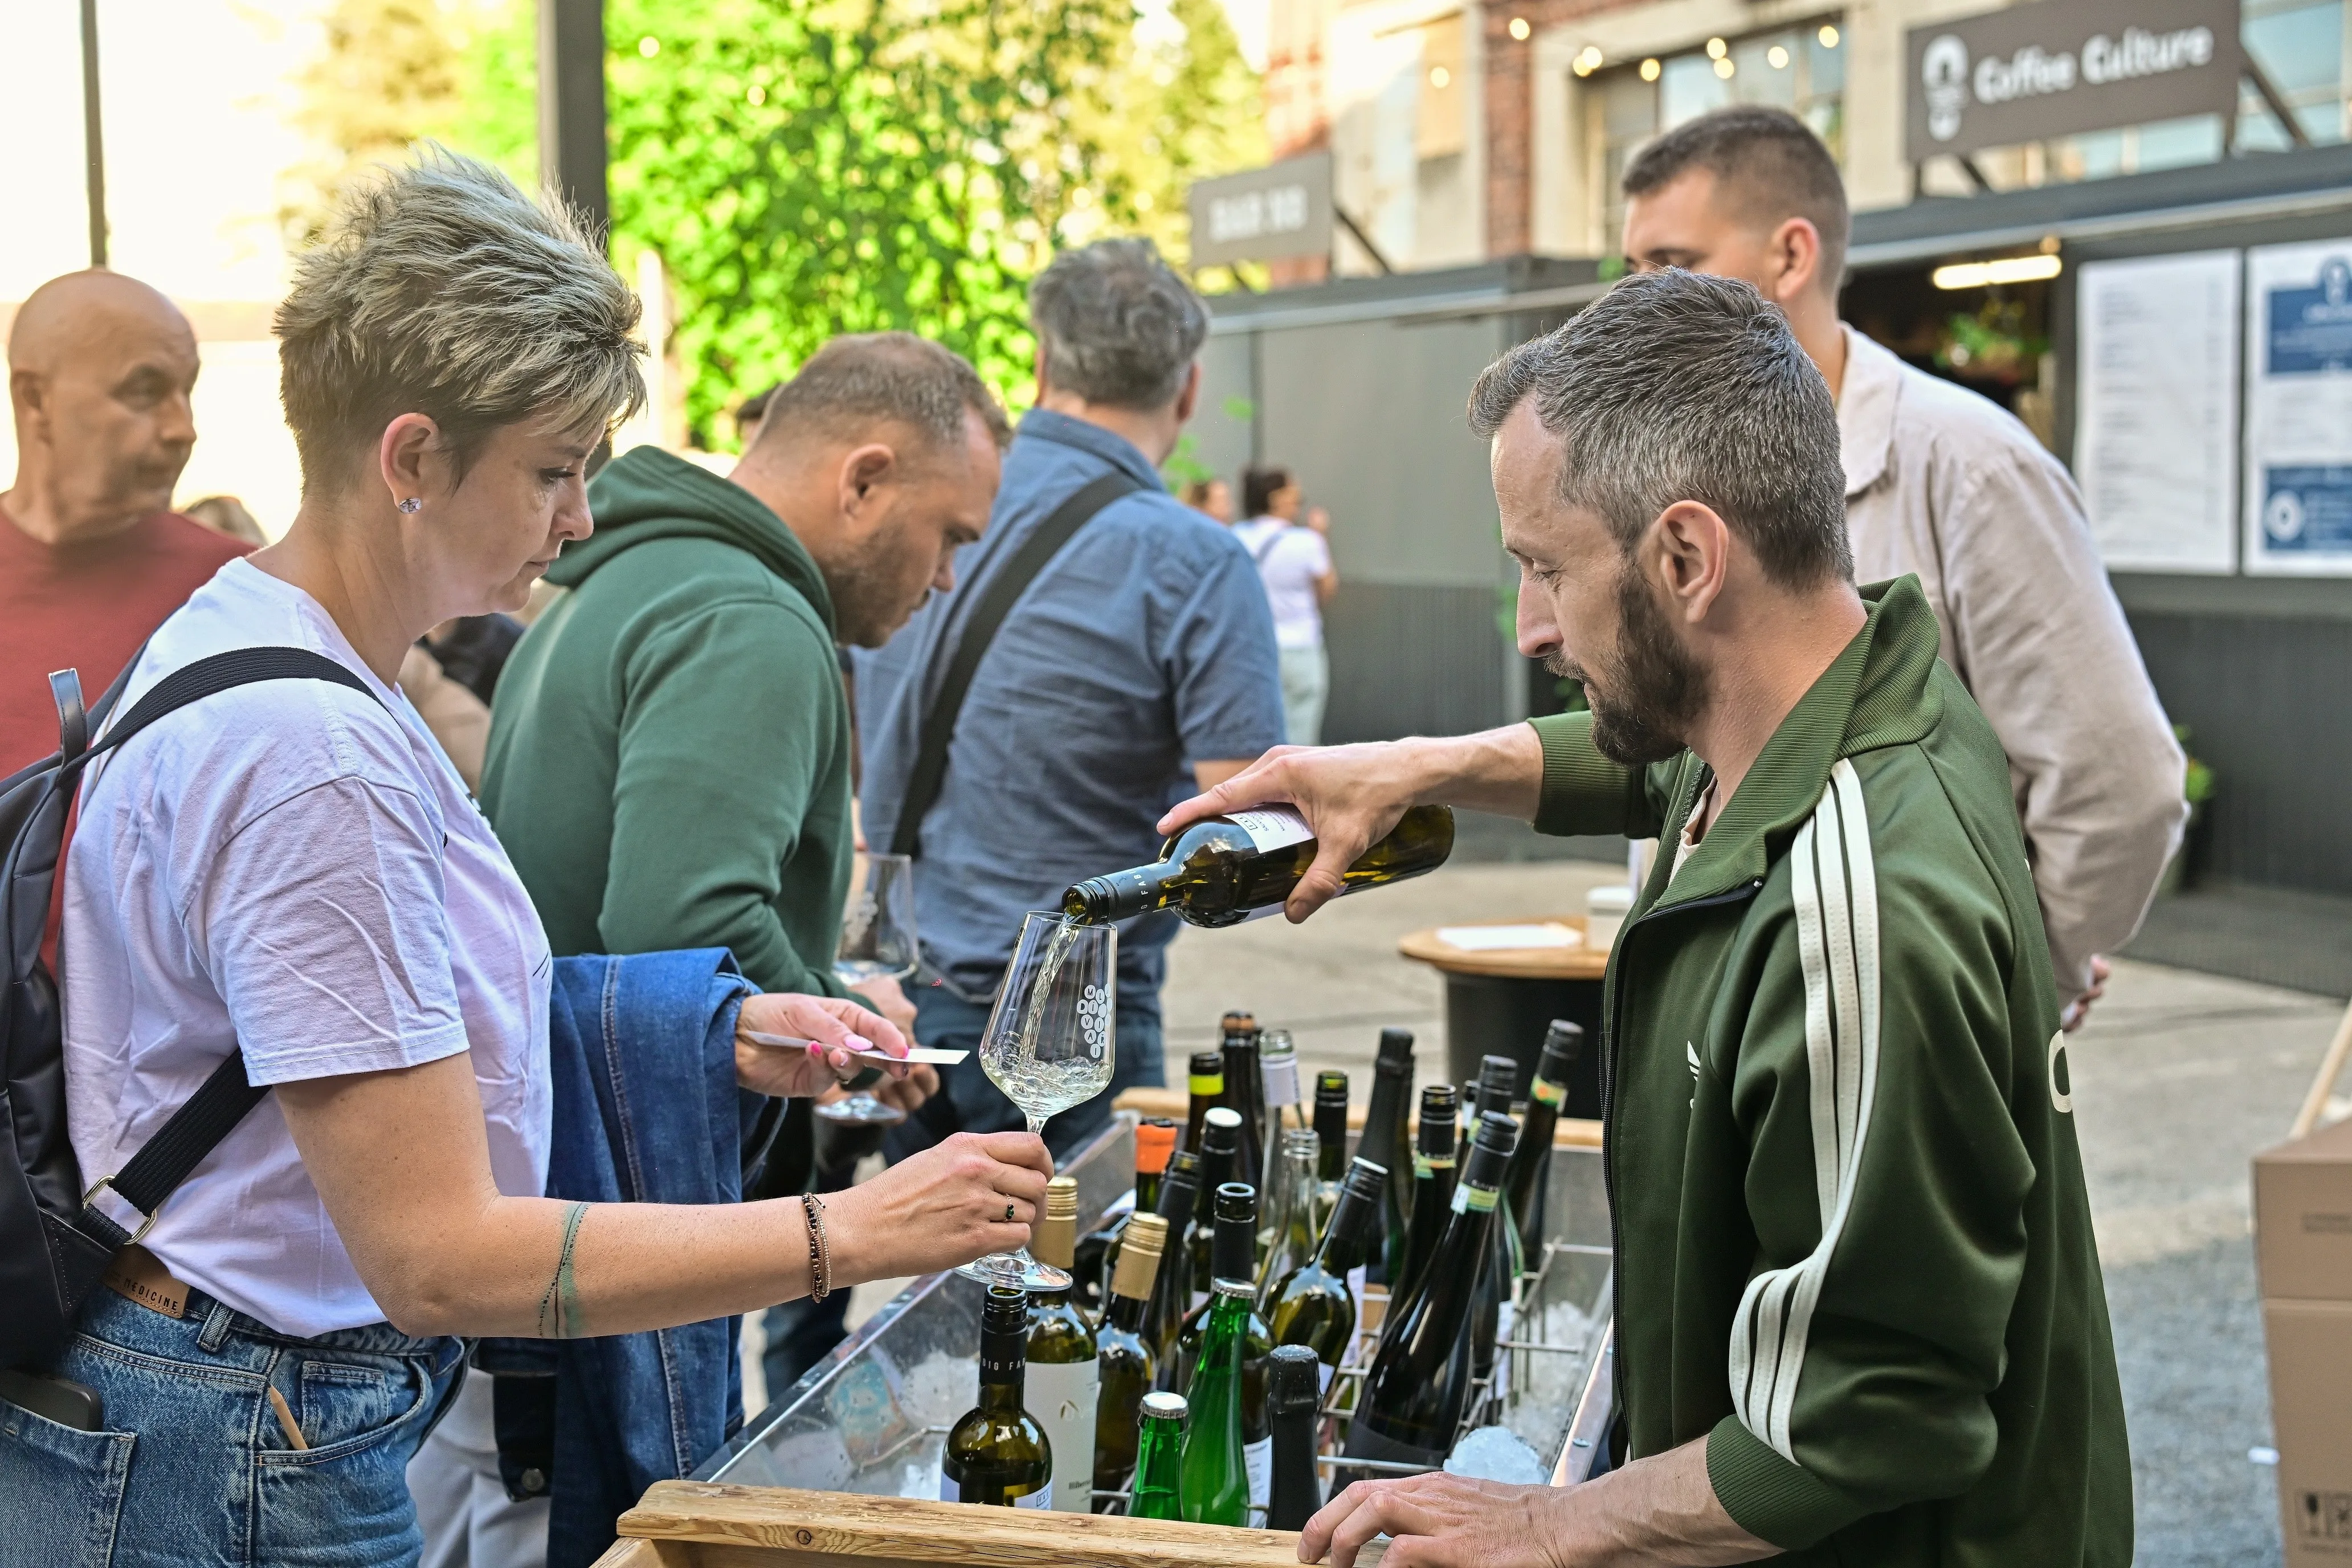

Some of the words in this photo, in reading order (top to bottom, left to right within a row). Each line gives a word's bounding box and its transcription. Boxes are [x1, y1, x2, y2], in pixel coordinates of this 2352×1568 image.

[1974, 45, 2077, 103] Coffee
[2081, 26, 2214, 84] Culture
[123, 1277, 178, 1311] MEDICINE
